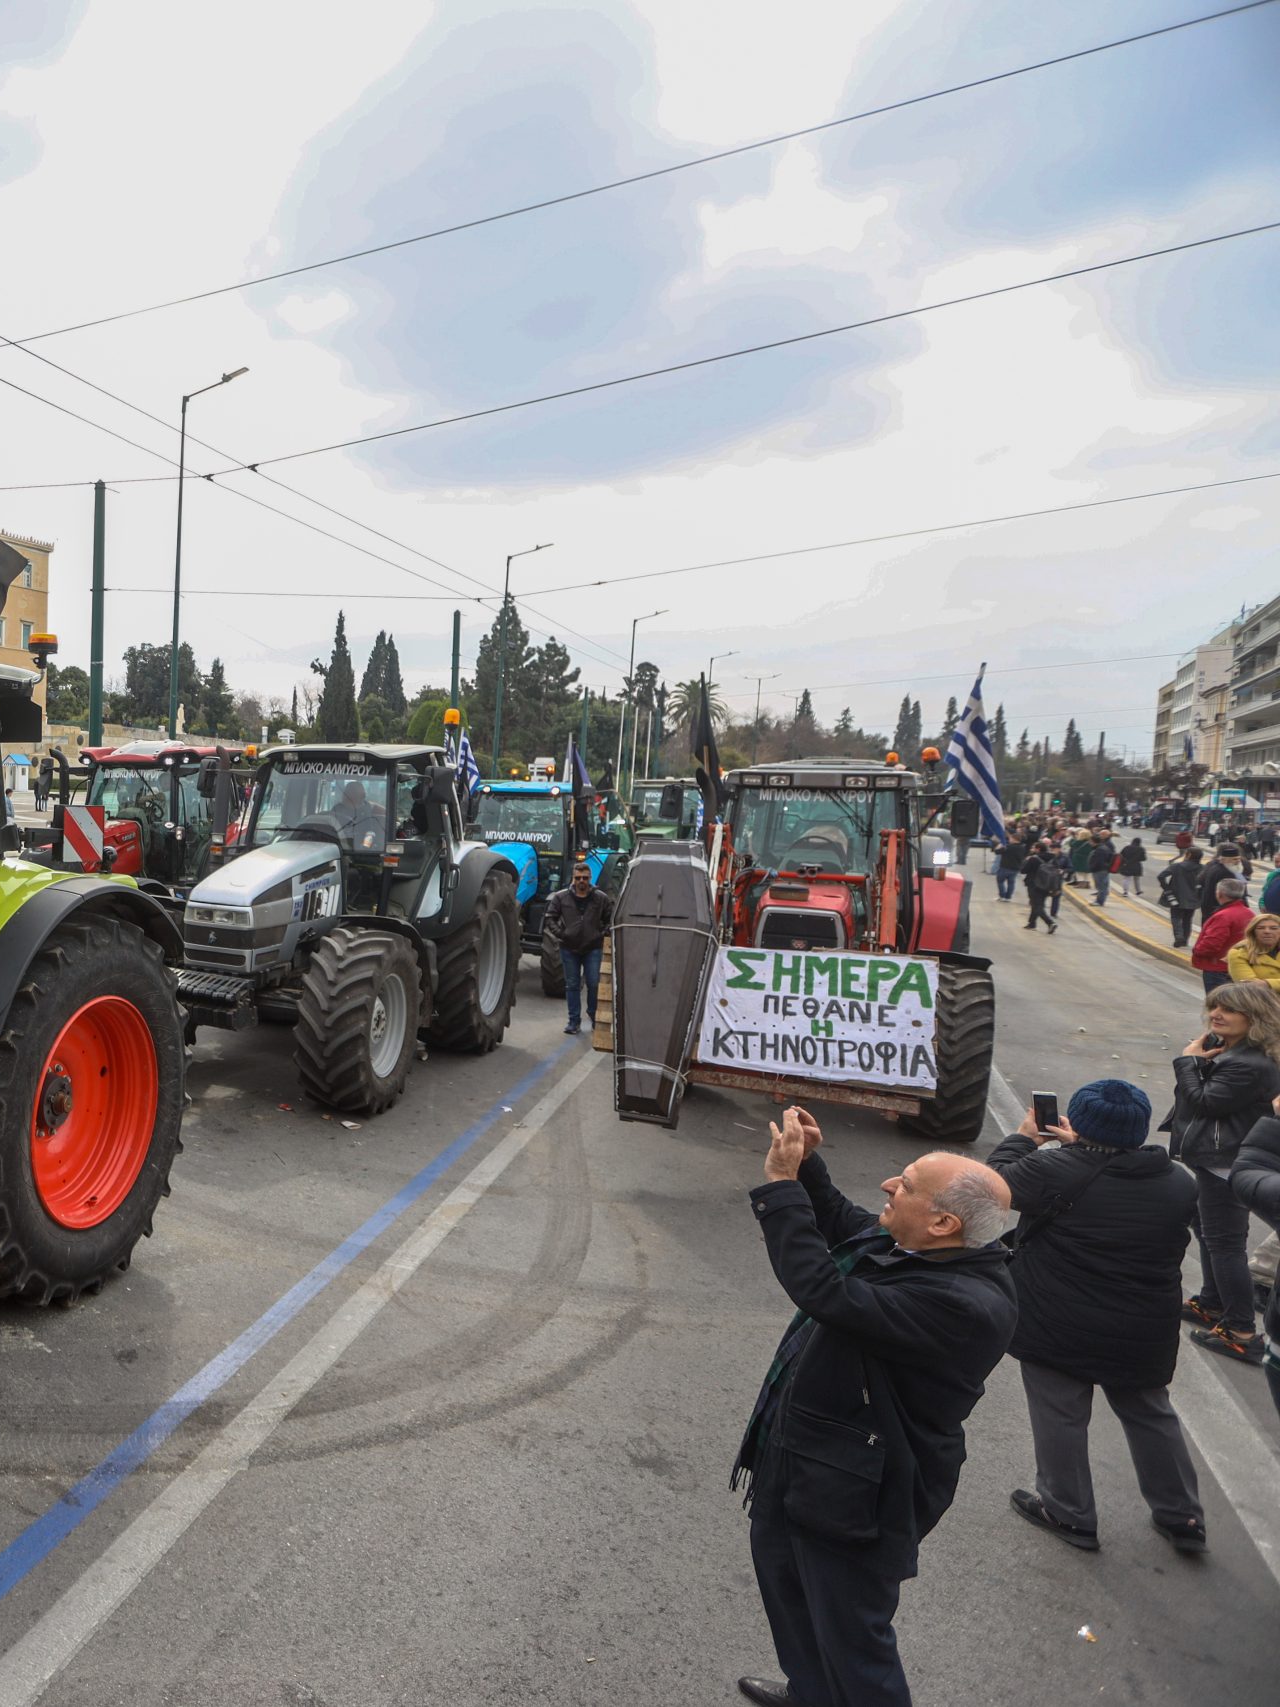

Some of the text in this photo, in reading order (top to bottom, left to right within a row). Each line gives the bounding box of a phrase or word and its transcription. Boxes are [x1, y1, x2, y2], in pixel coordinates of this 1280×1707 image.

[284, 762, 372, 776] ΜΠΛΟΚΟ ΑΛΜΥΡΟΥ
[760, 788, 811, 801] ΜΠΛΟΚΟ
[485, 831, 553, 843] ΜΠΛΟΚΟ ΑΛΜΥΡΟΥ
[726, 950, 933, 1009] ΣΗΜΕΡΑ
[762, 994, 898, 1027] ΠΕΘΑΝΕ
[810, 1019, 834, 1038] Η
[712, 1027, 937, 1078] ΚΤΗΝΟΤΡΟΦΙΑ
